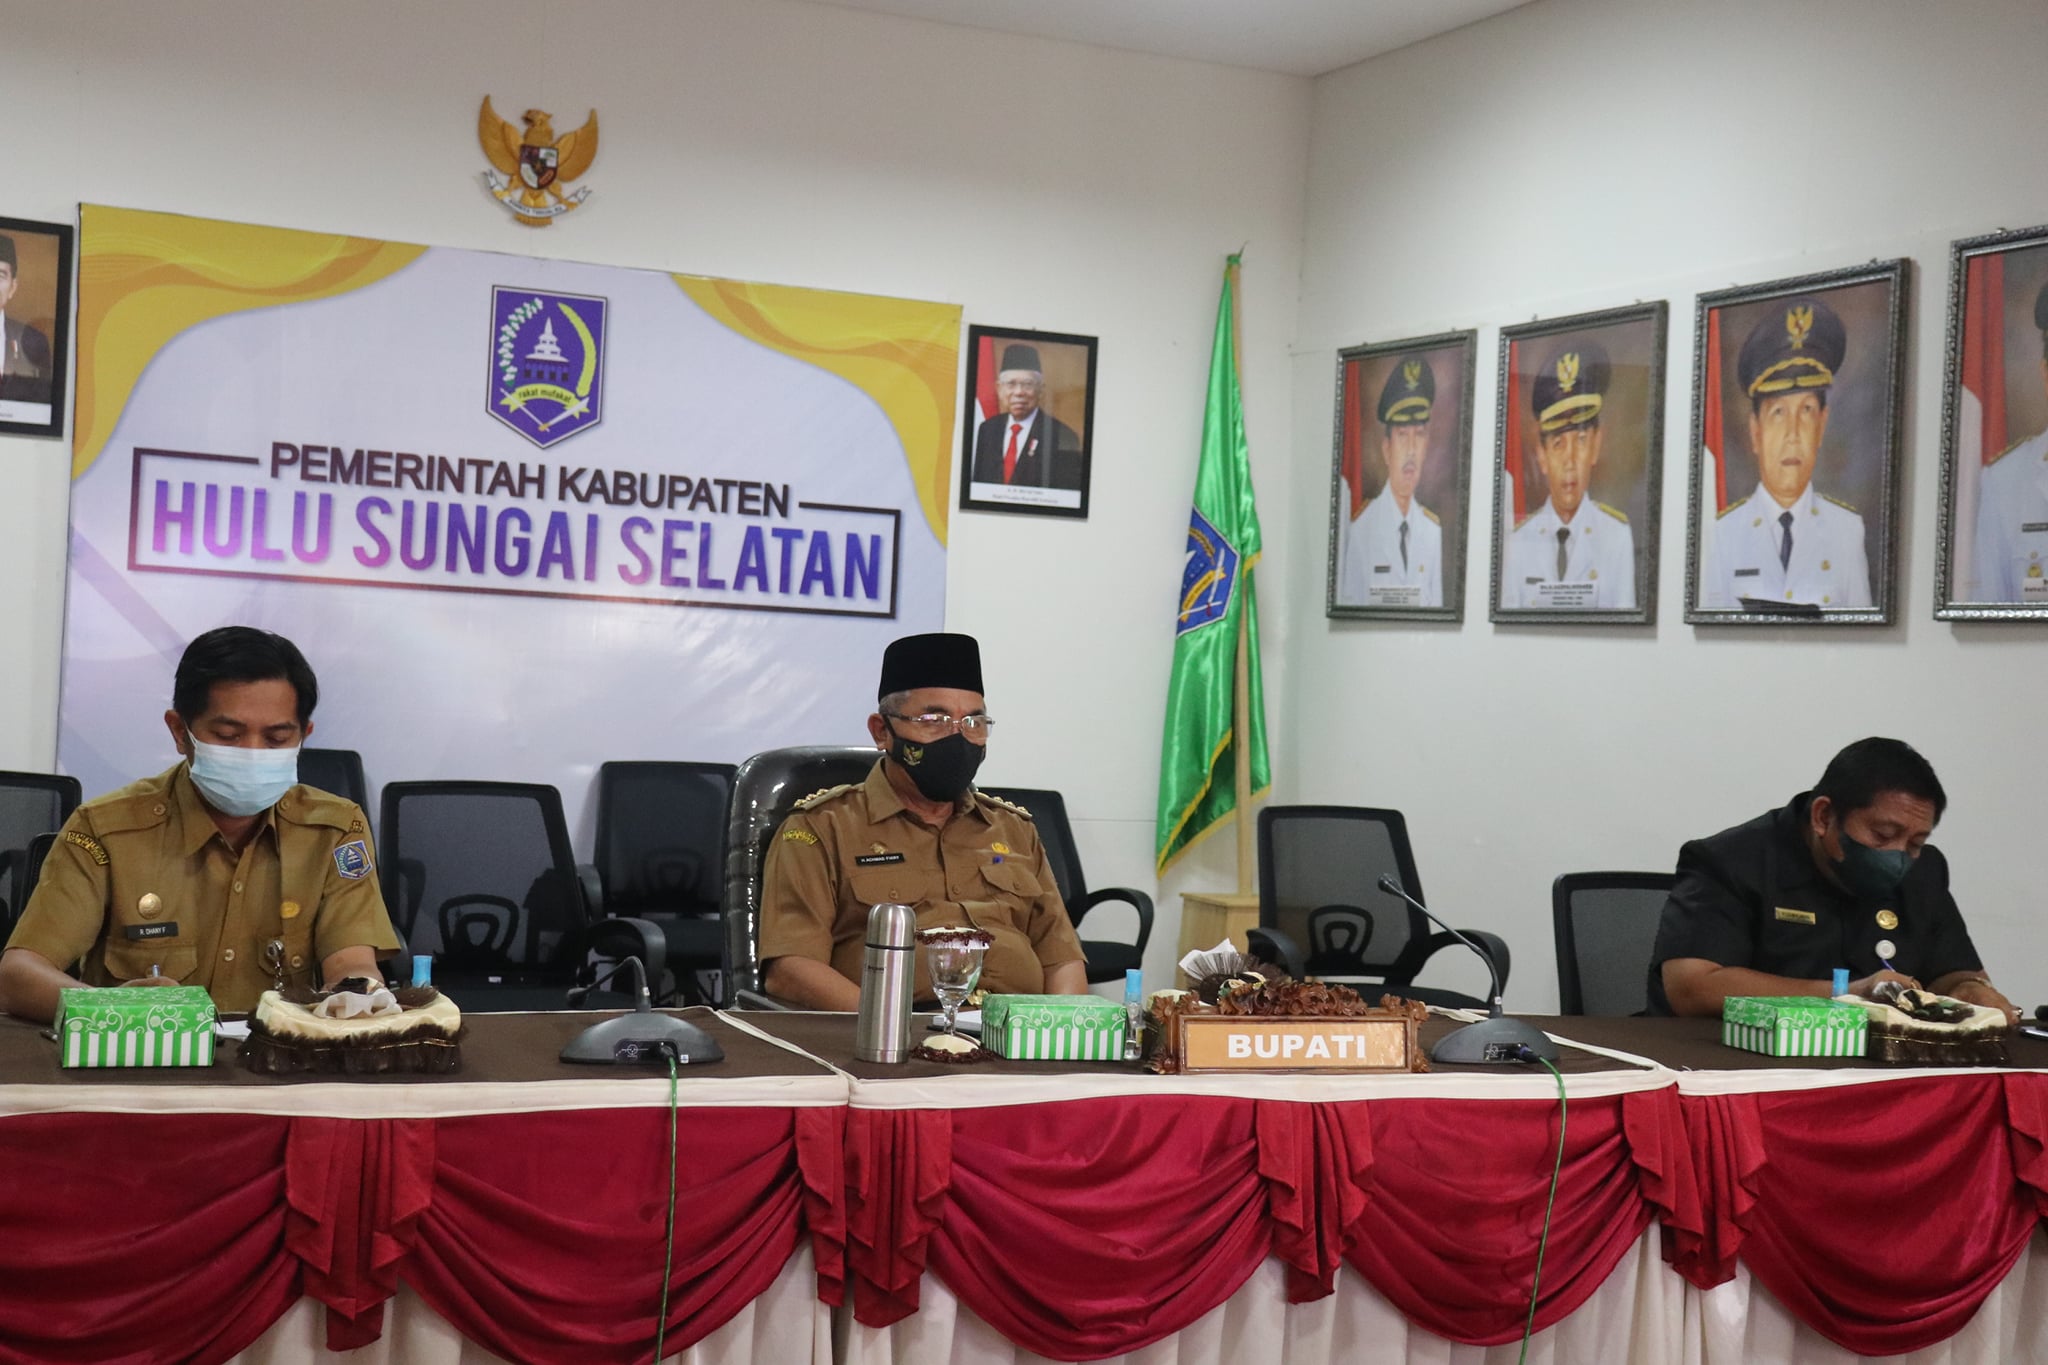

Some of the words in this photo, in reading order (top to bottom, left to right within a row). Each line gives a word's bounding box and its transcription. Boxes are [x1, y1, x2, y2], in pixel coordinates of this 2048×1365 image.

[270, 441, 546, 500] PEMERINTAH
[558, 466, 789, 518] KABUPATEN
[153, 480, 333, 564] HULU
[353, 496, 599, 582] SUNGAI
[617, 516, 881, 600] SELATAN
[1227, 1034, 1366, 1059] BUPATI
